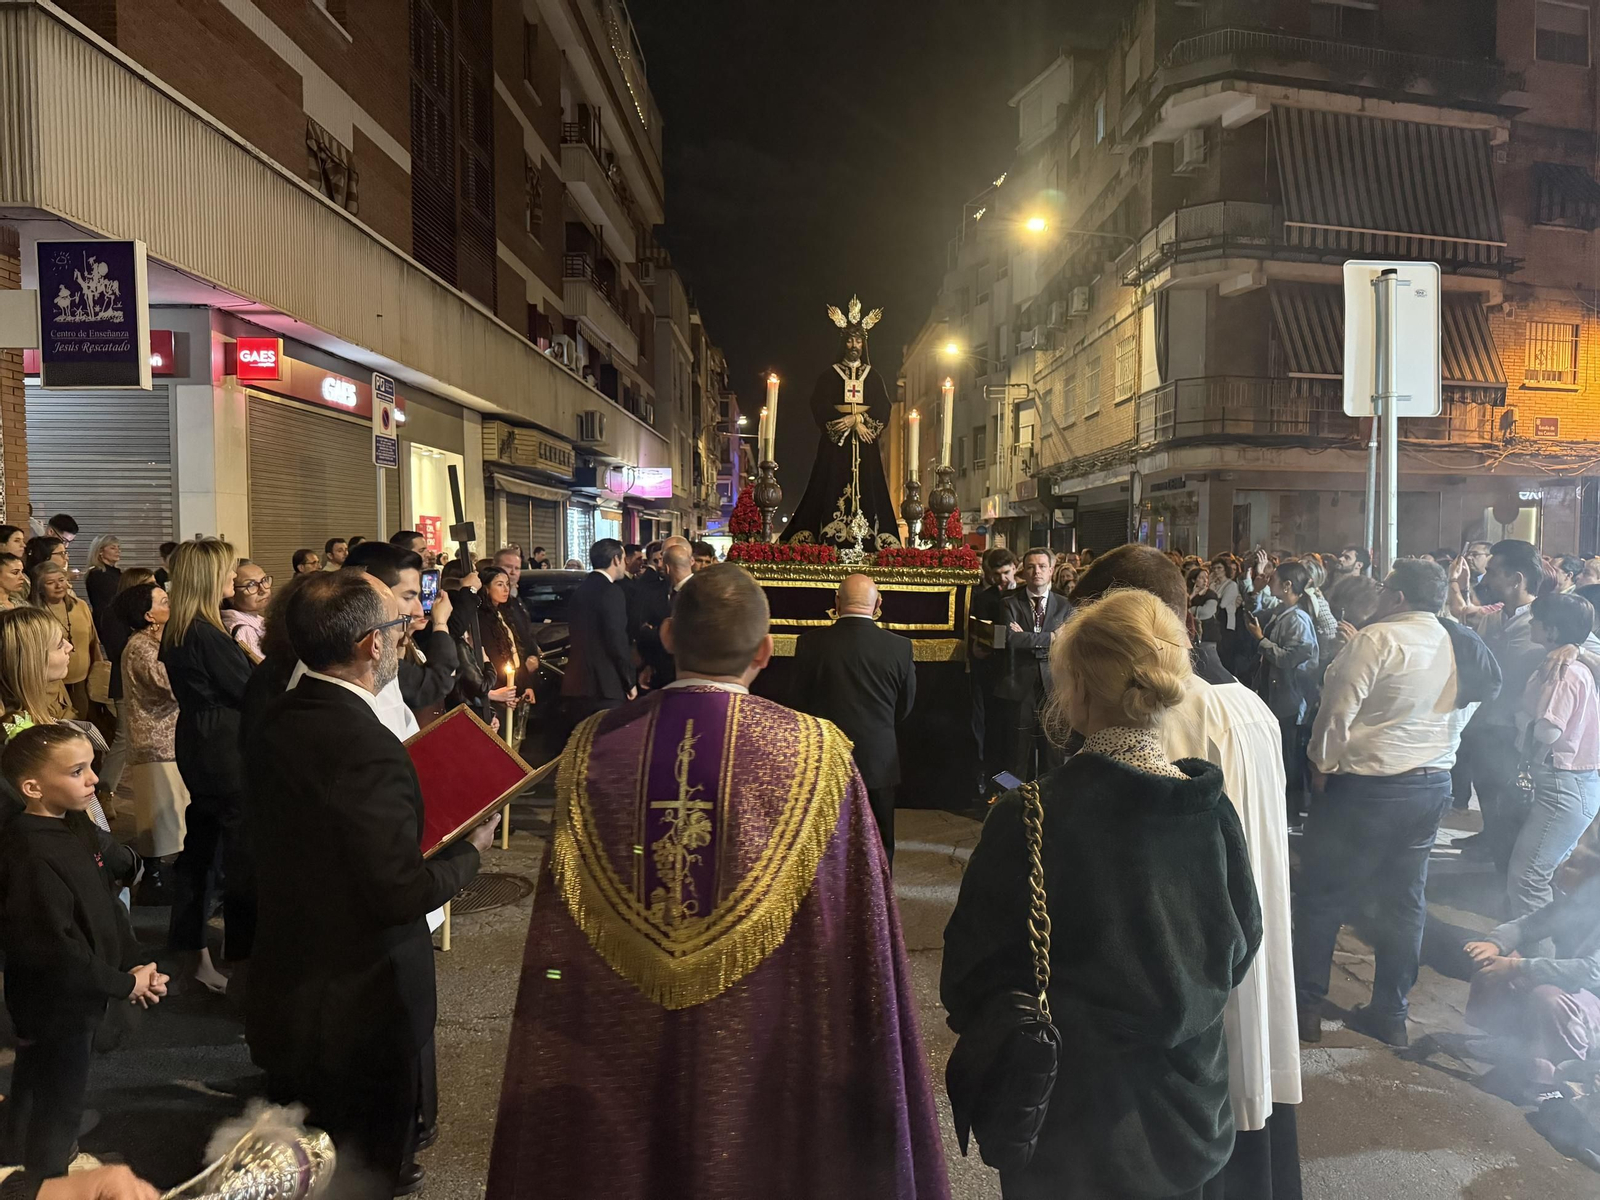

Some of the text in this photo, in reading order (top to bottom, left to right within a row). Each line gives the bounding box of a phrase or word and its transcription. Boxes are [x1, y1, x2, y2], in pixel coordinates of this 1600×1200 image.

[50, 329, 129, 338] Centro de Enseñanza
[52, 340, 130, 353] Jesús Rescatado
[240, 350, 275, 362] GAES
[322, 377, 357, 407] GAES
